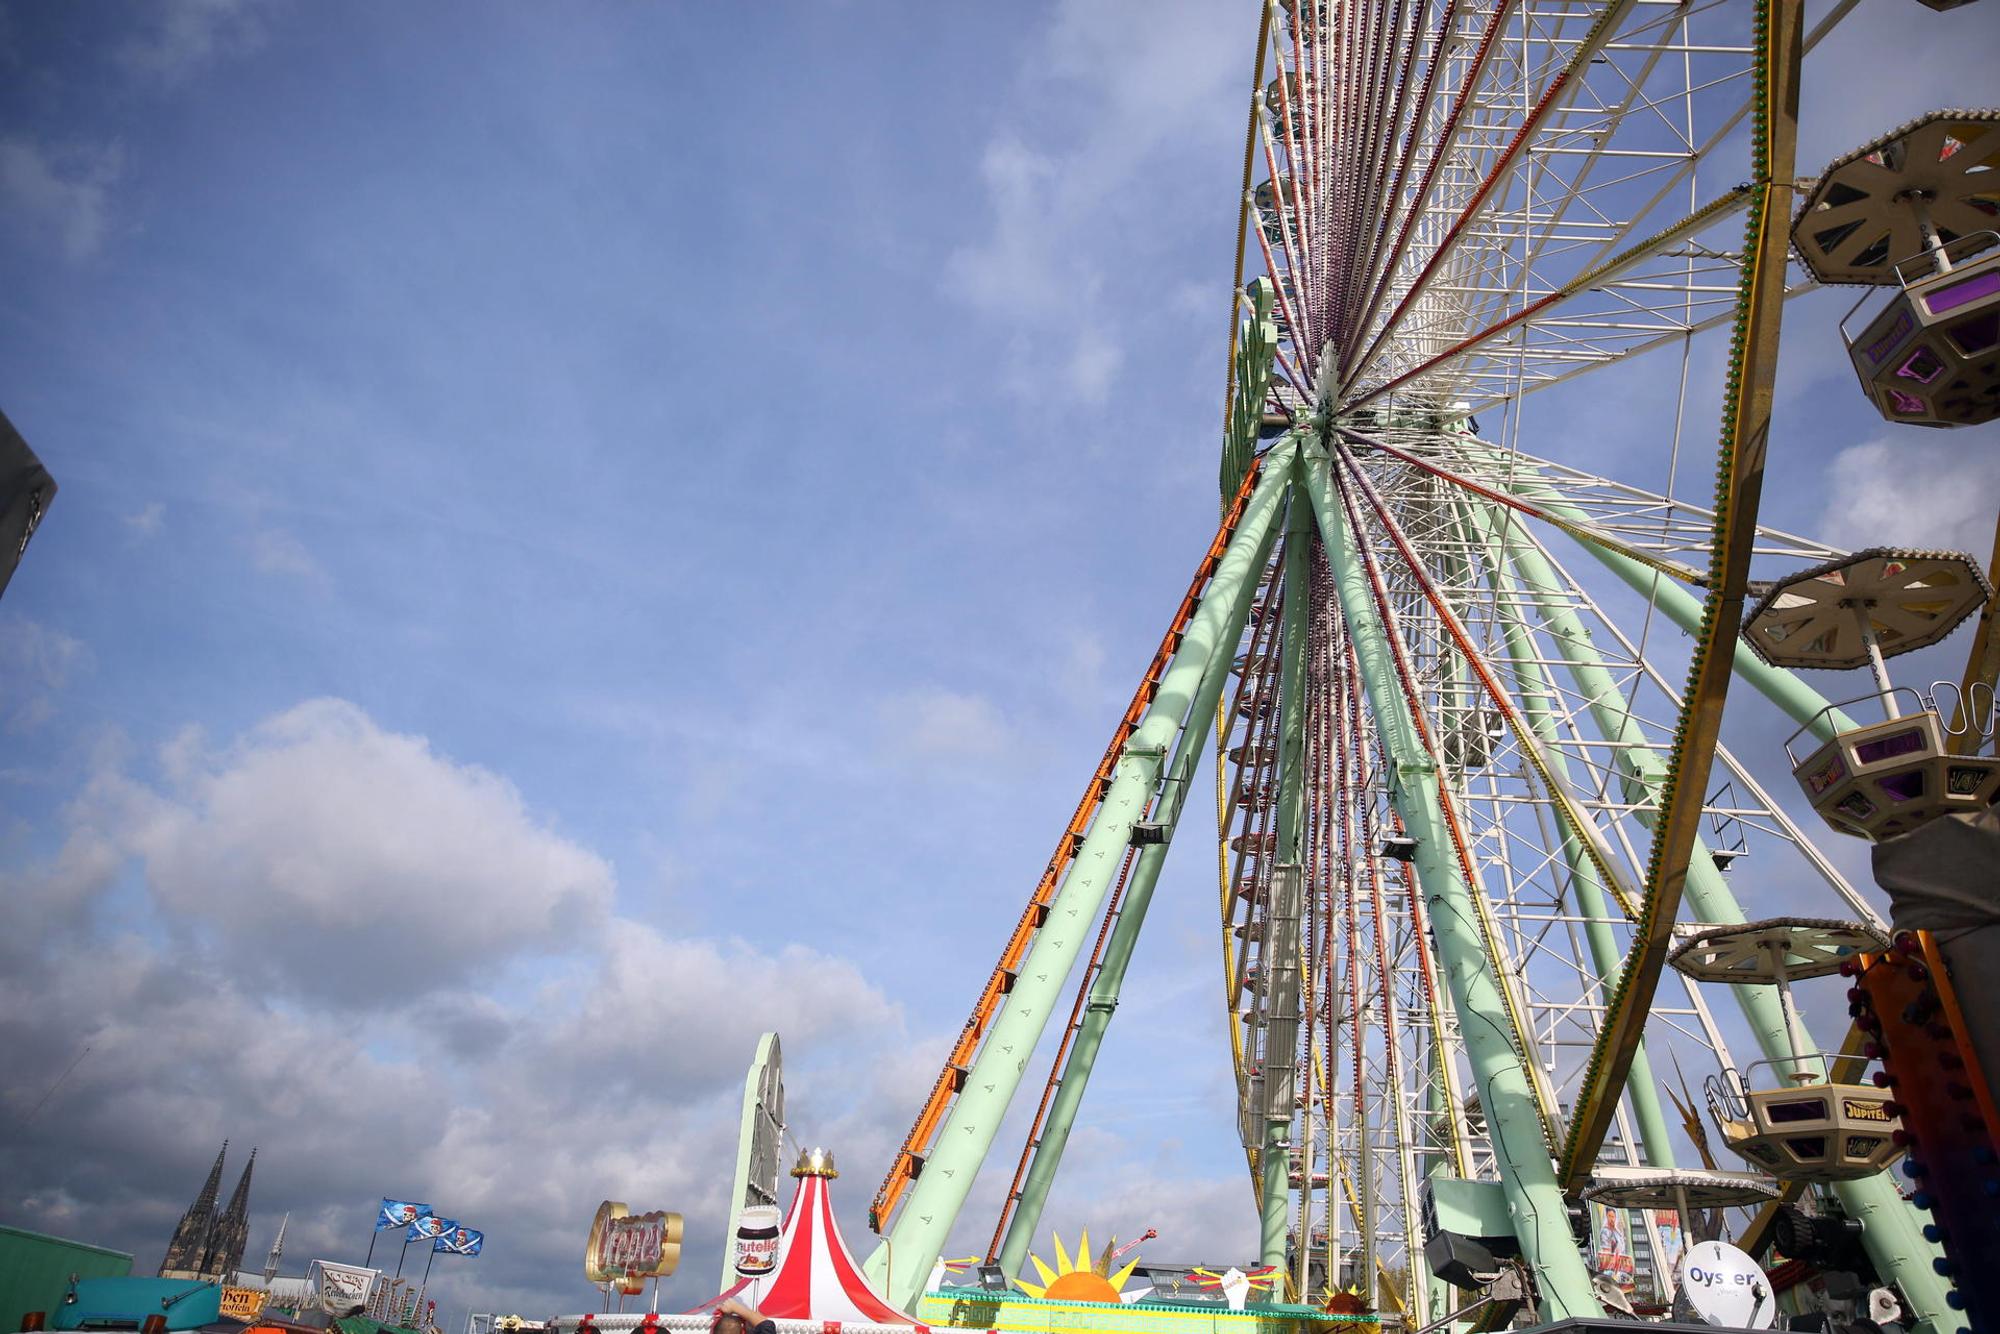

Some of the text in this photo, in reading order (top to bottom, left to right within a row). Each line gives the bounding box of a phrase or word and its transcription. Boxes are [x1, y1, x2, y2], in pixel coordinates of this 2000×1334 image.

[737, 1239, 777, 1252] nutella
[1690, 1267, 1755, 1287] Oyser
[222, 1290, 249, 1303] hen
[222, 1303, 250, 1312] toffeln
